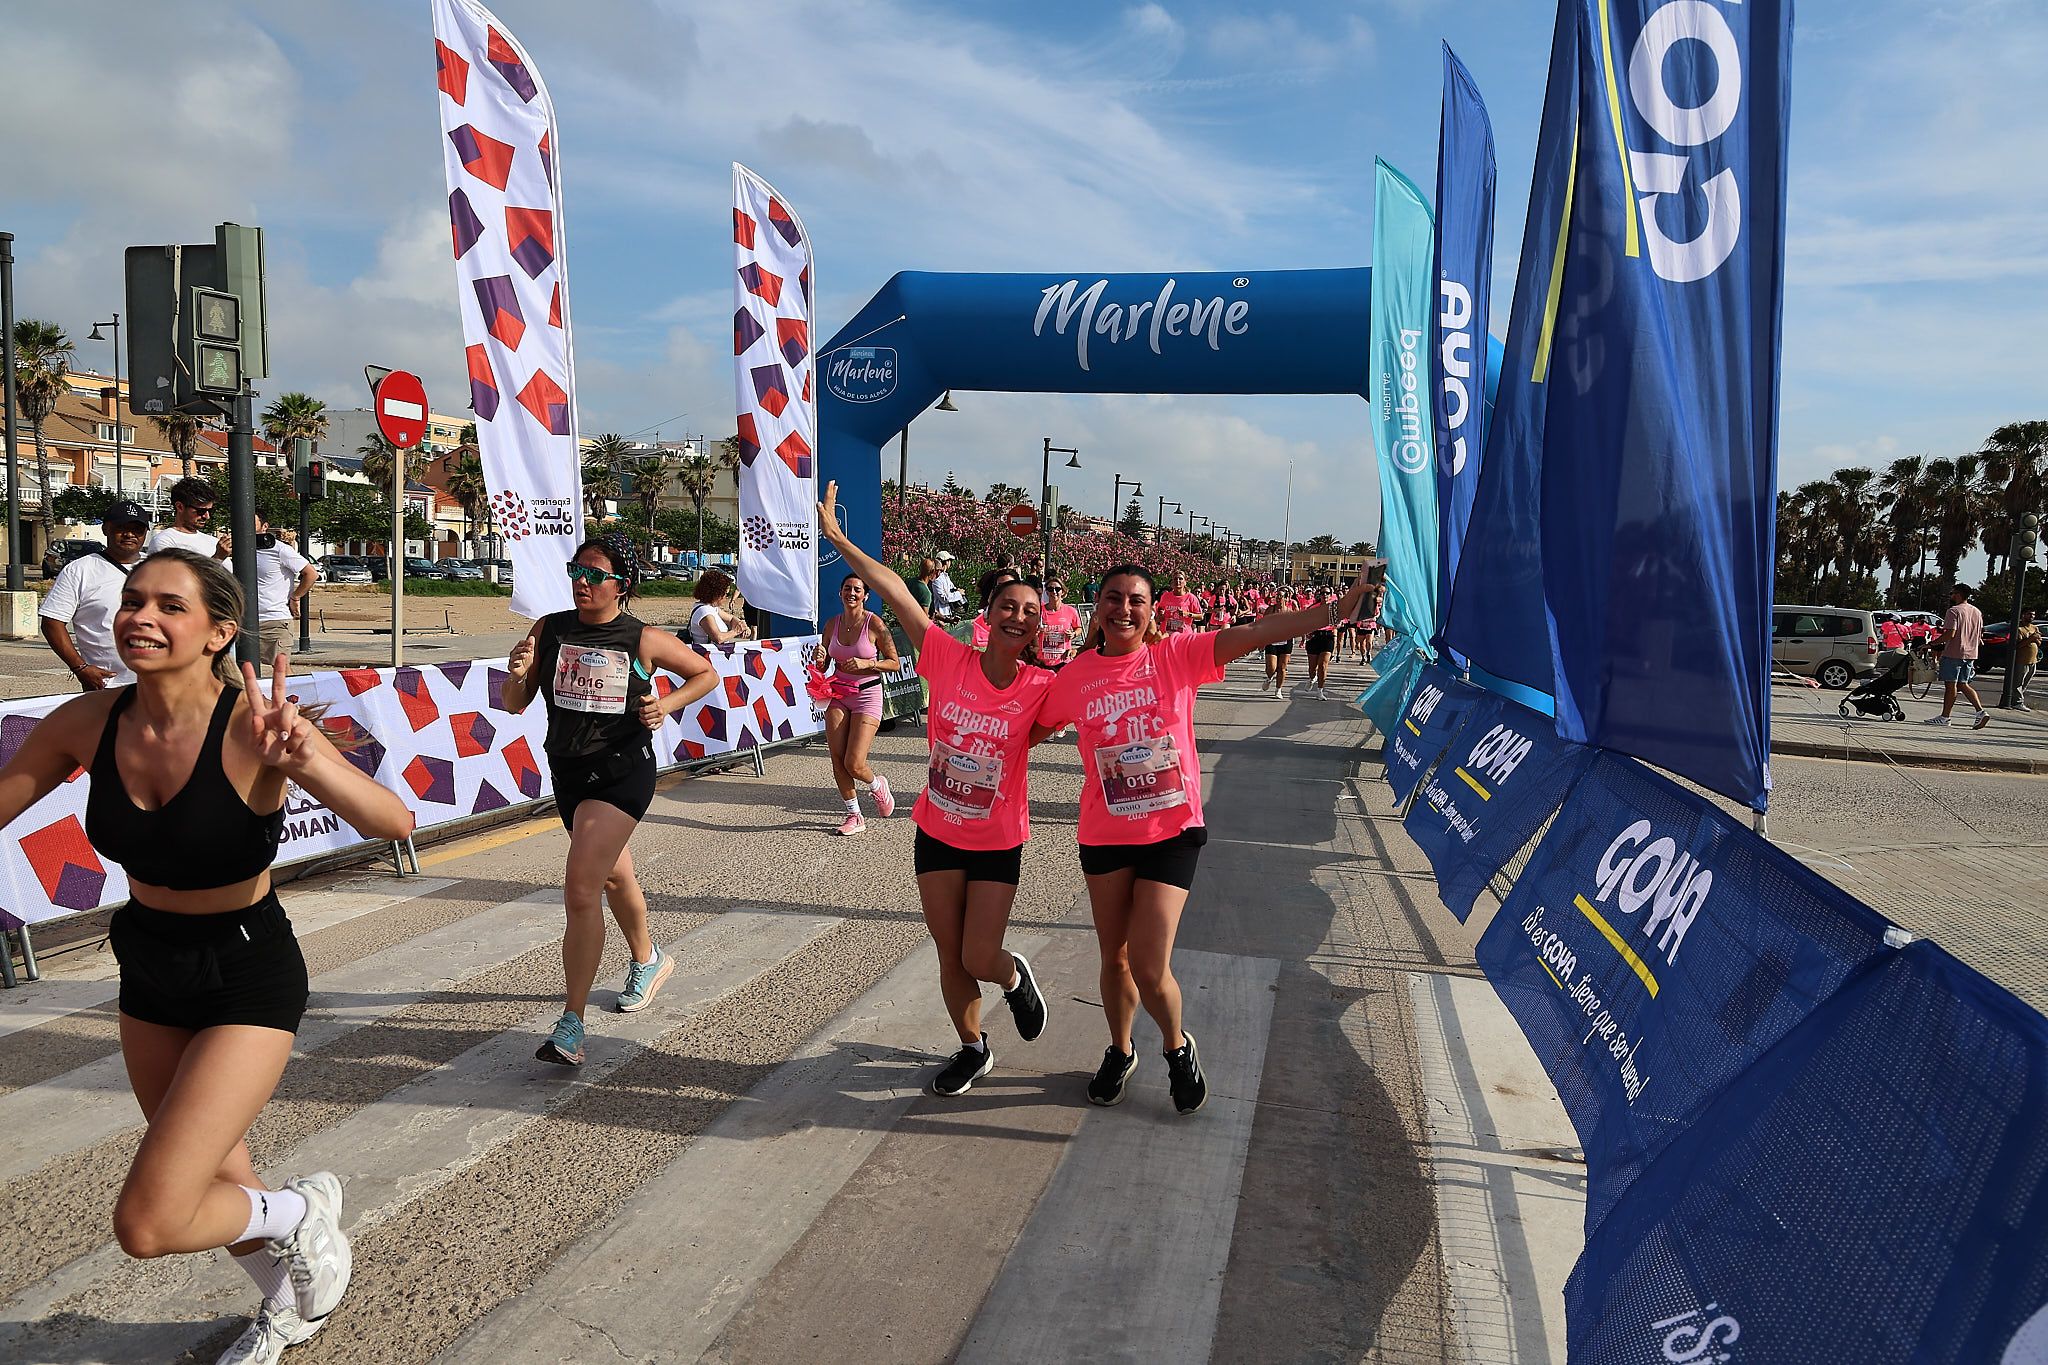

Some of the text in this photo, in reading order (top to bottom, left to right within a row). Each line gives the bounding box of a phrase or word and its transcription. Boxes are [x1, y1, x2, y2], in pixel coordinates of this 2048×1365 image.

[833, 384, 846, 396] HIJA
[846, 391, 855, 399] DE
[869, 388, 888, 399] ALPES
[577, 676, 604, 690] 016
[1080, 678, 1109, 695] OYSHO
[1121, 751, 1151, 762] ASTURIANA
[1465, 723, 1534, 786] GOYA
[945, 777, 973, 795] 016
[1126, 772, 1157, 788] 016
[1116, 803, 1141, 813] OYSHO
[1594, 819, 1713, 967] GOYA
[1531, 927, 1549, 947] es
[1542, 933, 1577, 982] GOYA
[1582, 1009, 1618, 1045] que
[1608, 1032, 1630, 1061] ser
[1620, 1036, 1651, 1107] bueno!
